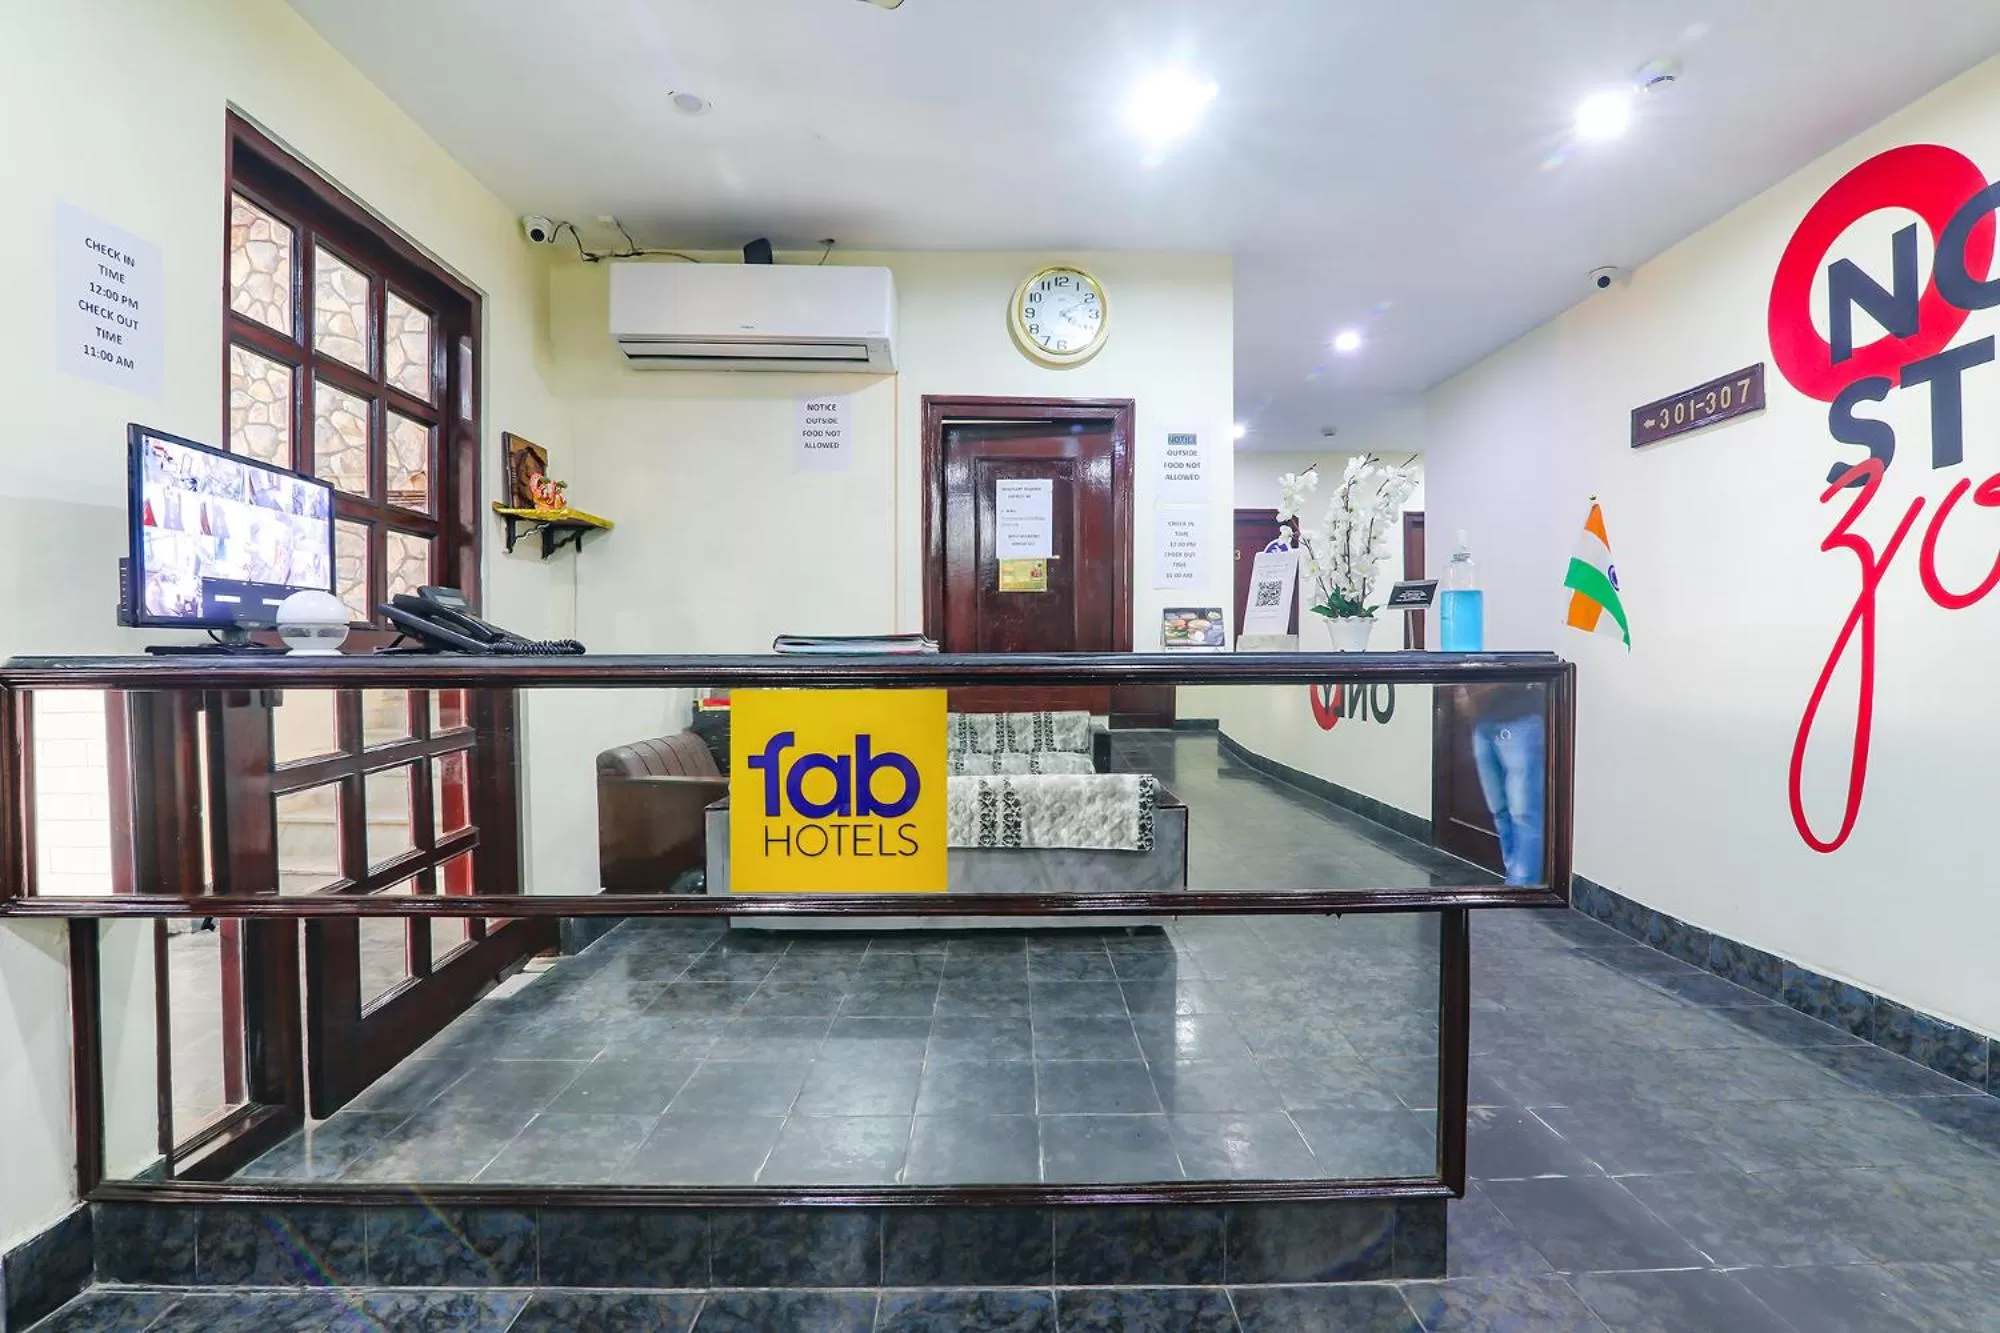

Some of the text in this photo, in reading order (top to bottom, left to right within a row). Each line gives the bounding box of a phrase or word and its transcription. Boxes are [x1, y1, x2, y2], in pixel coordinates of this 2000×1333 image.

[85, 238, 135, 267] CHECK IN
[98, 264, 126, 284] TIME
[1041, 280, 1050, 291] 11
[1055, 276, 1073, 288] 12
[1076, 282, 1080, 291] 1
[89, 282, 138, 310] 12:00 PM
[1030, 292, 1042, 303] 10
[1084, 292, 1096, 303] 2
[78, 299, 138, 330] CHECK OUT
[1024, 308, 1036, 318] 9
[1088, 308, 1099, 319] 3
[1029, 324, 1039, 334] 8
[96, 326, 122, 345] TIME
[1040, 336, 1051, 346] 7
[1057, 340, 1067, 350] 6
[84, 344, 134, 370] 11:00 AM
[806, 403, 837, 412] NOTICE
[1660, 378, 1750, 430] 301-307
[748, 731, 921, 818] fab
[765, 824, 918, 856] HOTELS
